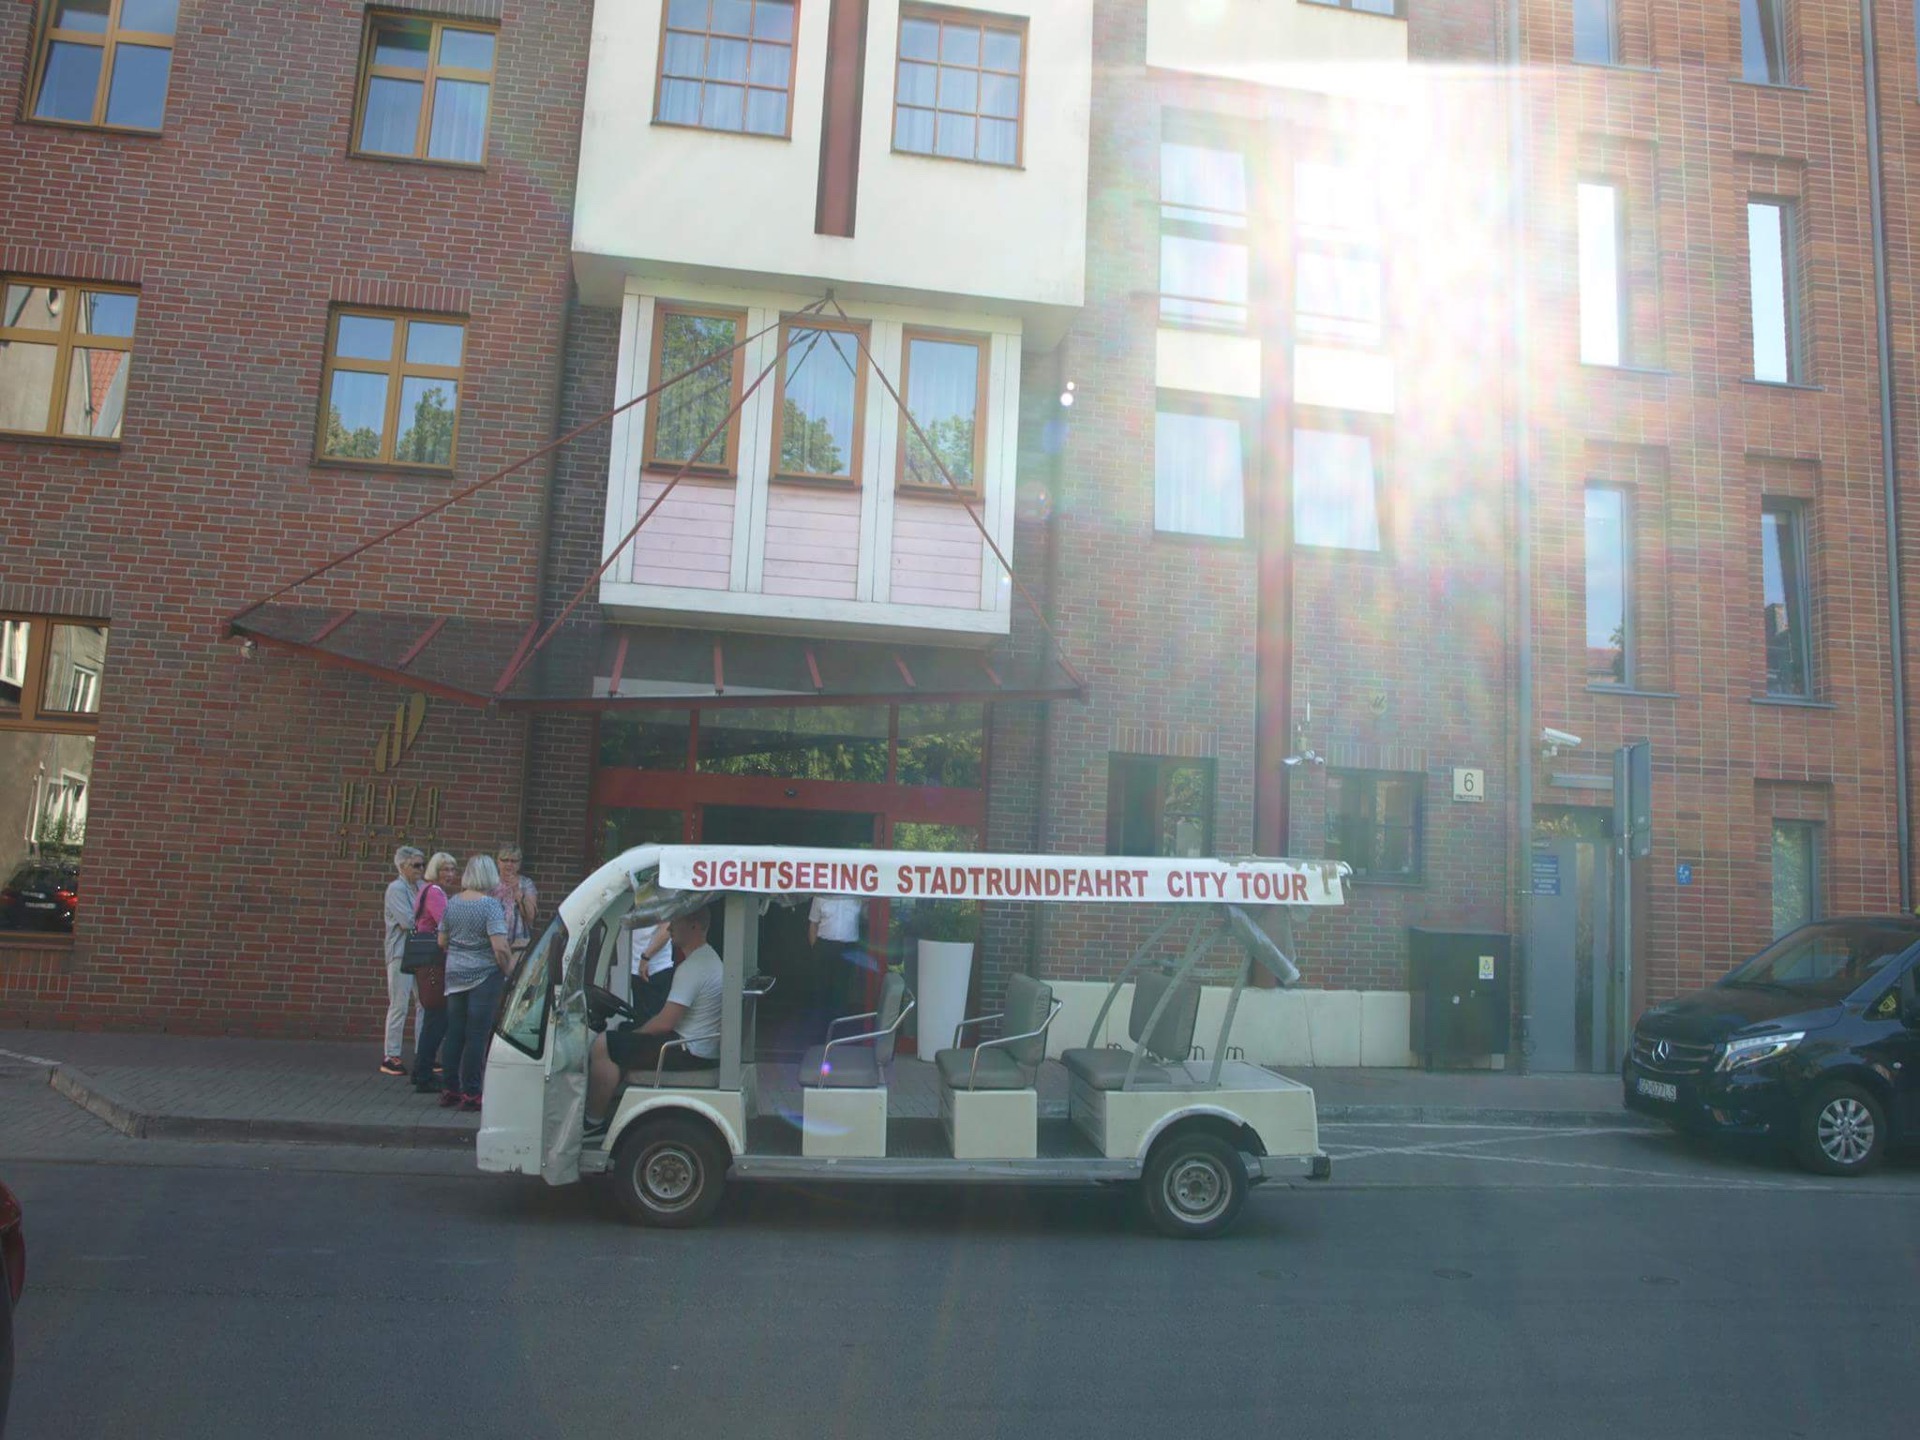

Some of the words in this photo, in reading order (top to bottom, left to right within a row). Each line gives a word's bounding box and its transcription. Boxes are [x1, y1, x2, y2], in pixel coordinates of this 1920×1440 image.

[1464, 772, 1474, 792] 6
[341, 781, 439, 828] HANZA
[692, 860, 879, 892] SIGHTSEEING
[897, 865, 1148, 897] STADTRUNDFAHRT
[1167, 870, 1228, 898] CITY
[1236, 872, 1309, 901] TOUR
